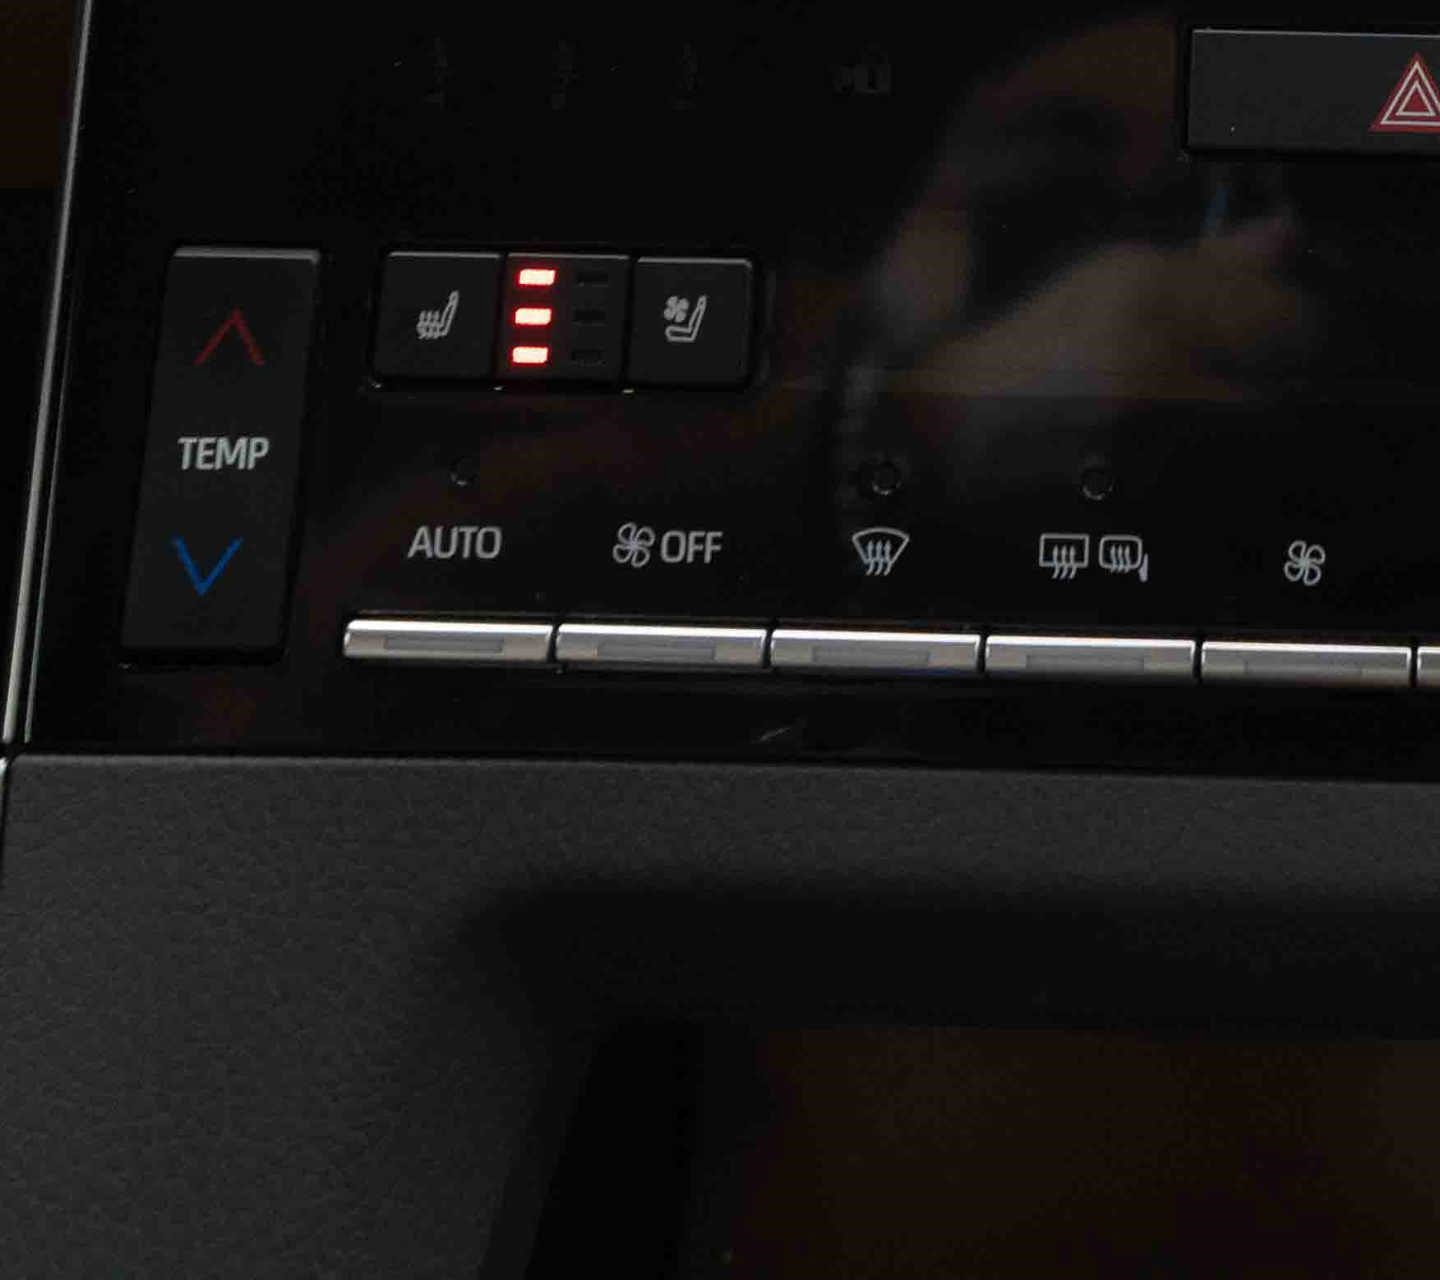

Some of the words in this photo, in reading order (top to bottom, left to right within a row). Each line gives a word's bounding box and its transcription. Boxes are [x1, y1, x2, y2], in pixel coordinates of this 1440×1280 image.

[178, 437, 269, 469] TEMP
[408, 526, 502, 559] AUTO
[661, 531, 722, 564] OFF
